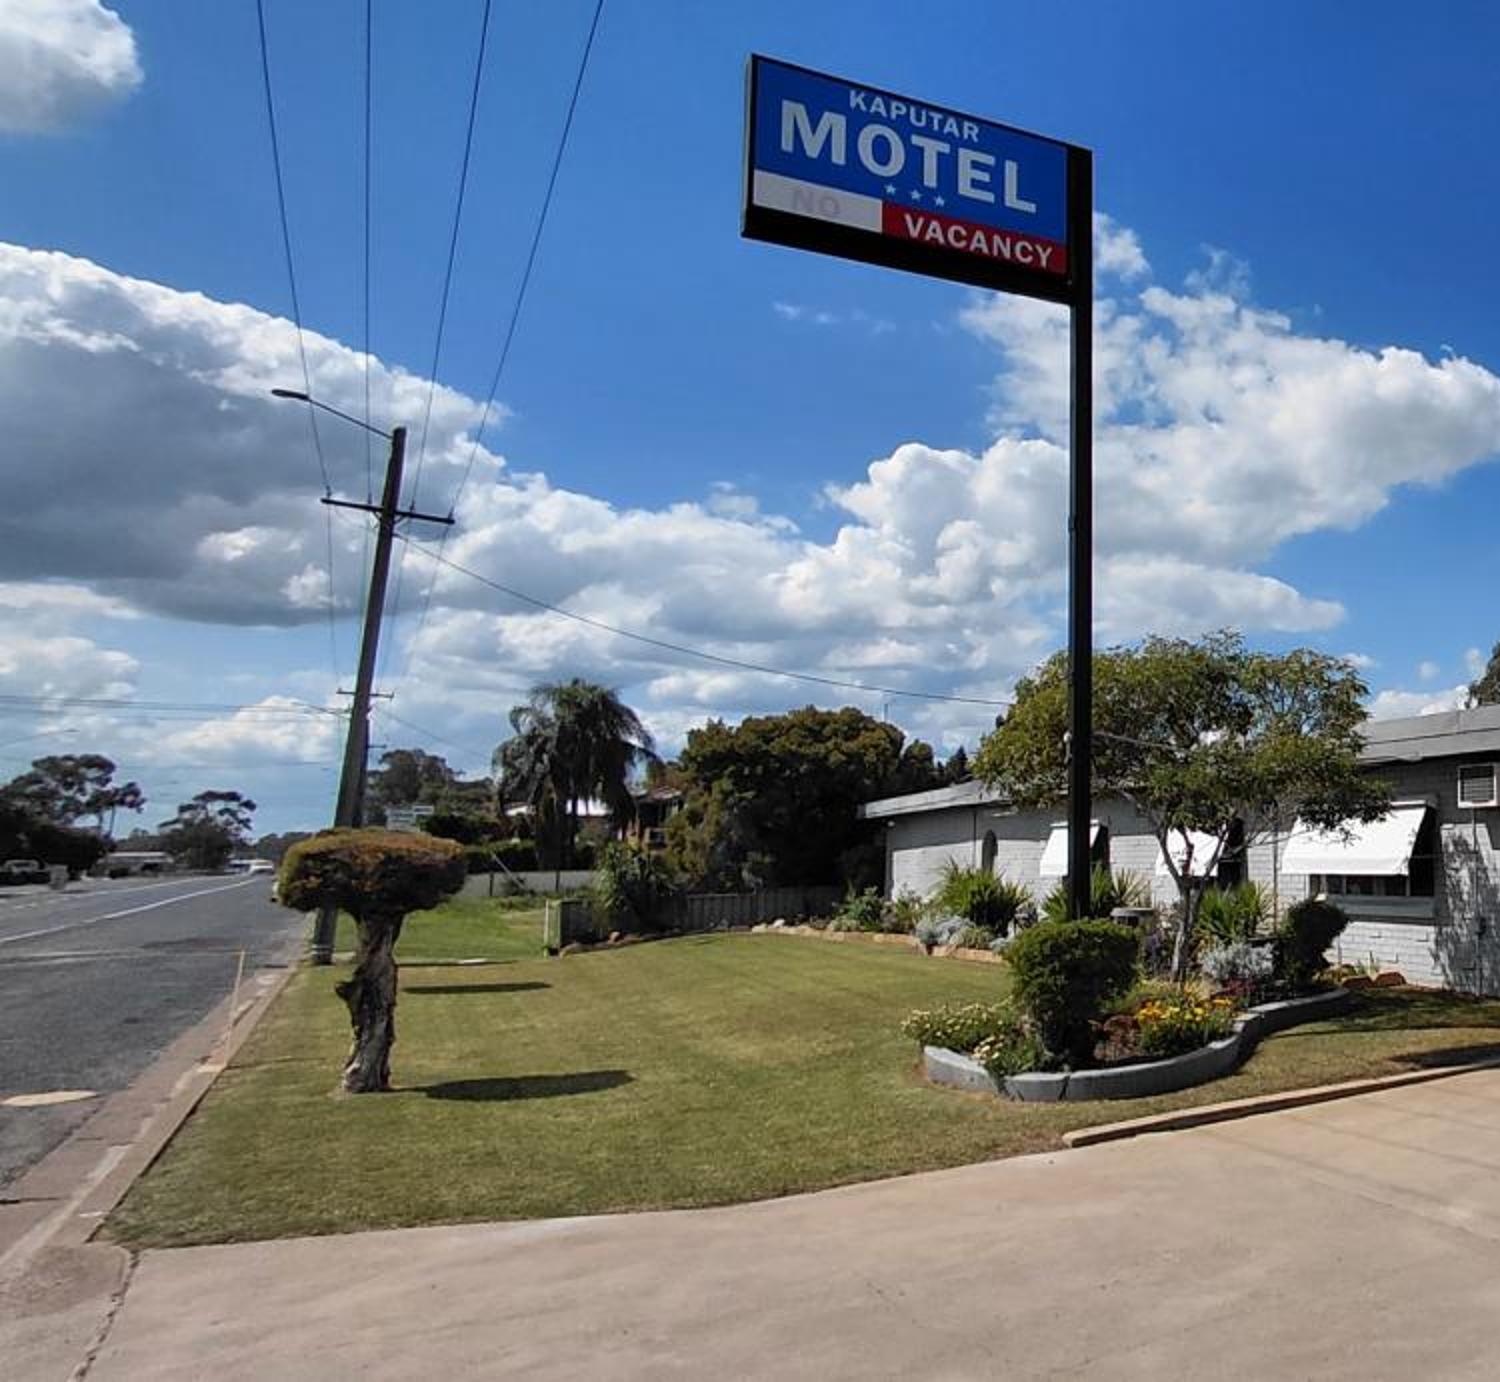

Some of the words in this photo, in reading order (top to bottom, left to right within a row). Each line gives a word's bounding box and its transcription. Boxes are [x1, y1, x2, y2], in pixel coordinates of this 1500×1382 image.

[849, 89, 980, 142] KAPUTAR
[781, 99, 1037, 214] MOTEL
[791, 187, 841, 216] NO
[904, 213, 1053, 268] VACANCY
